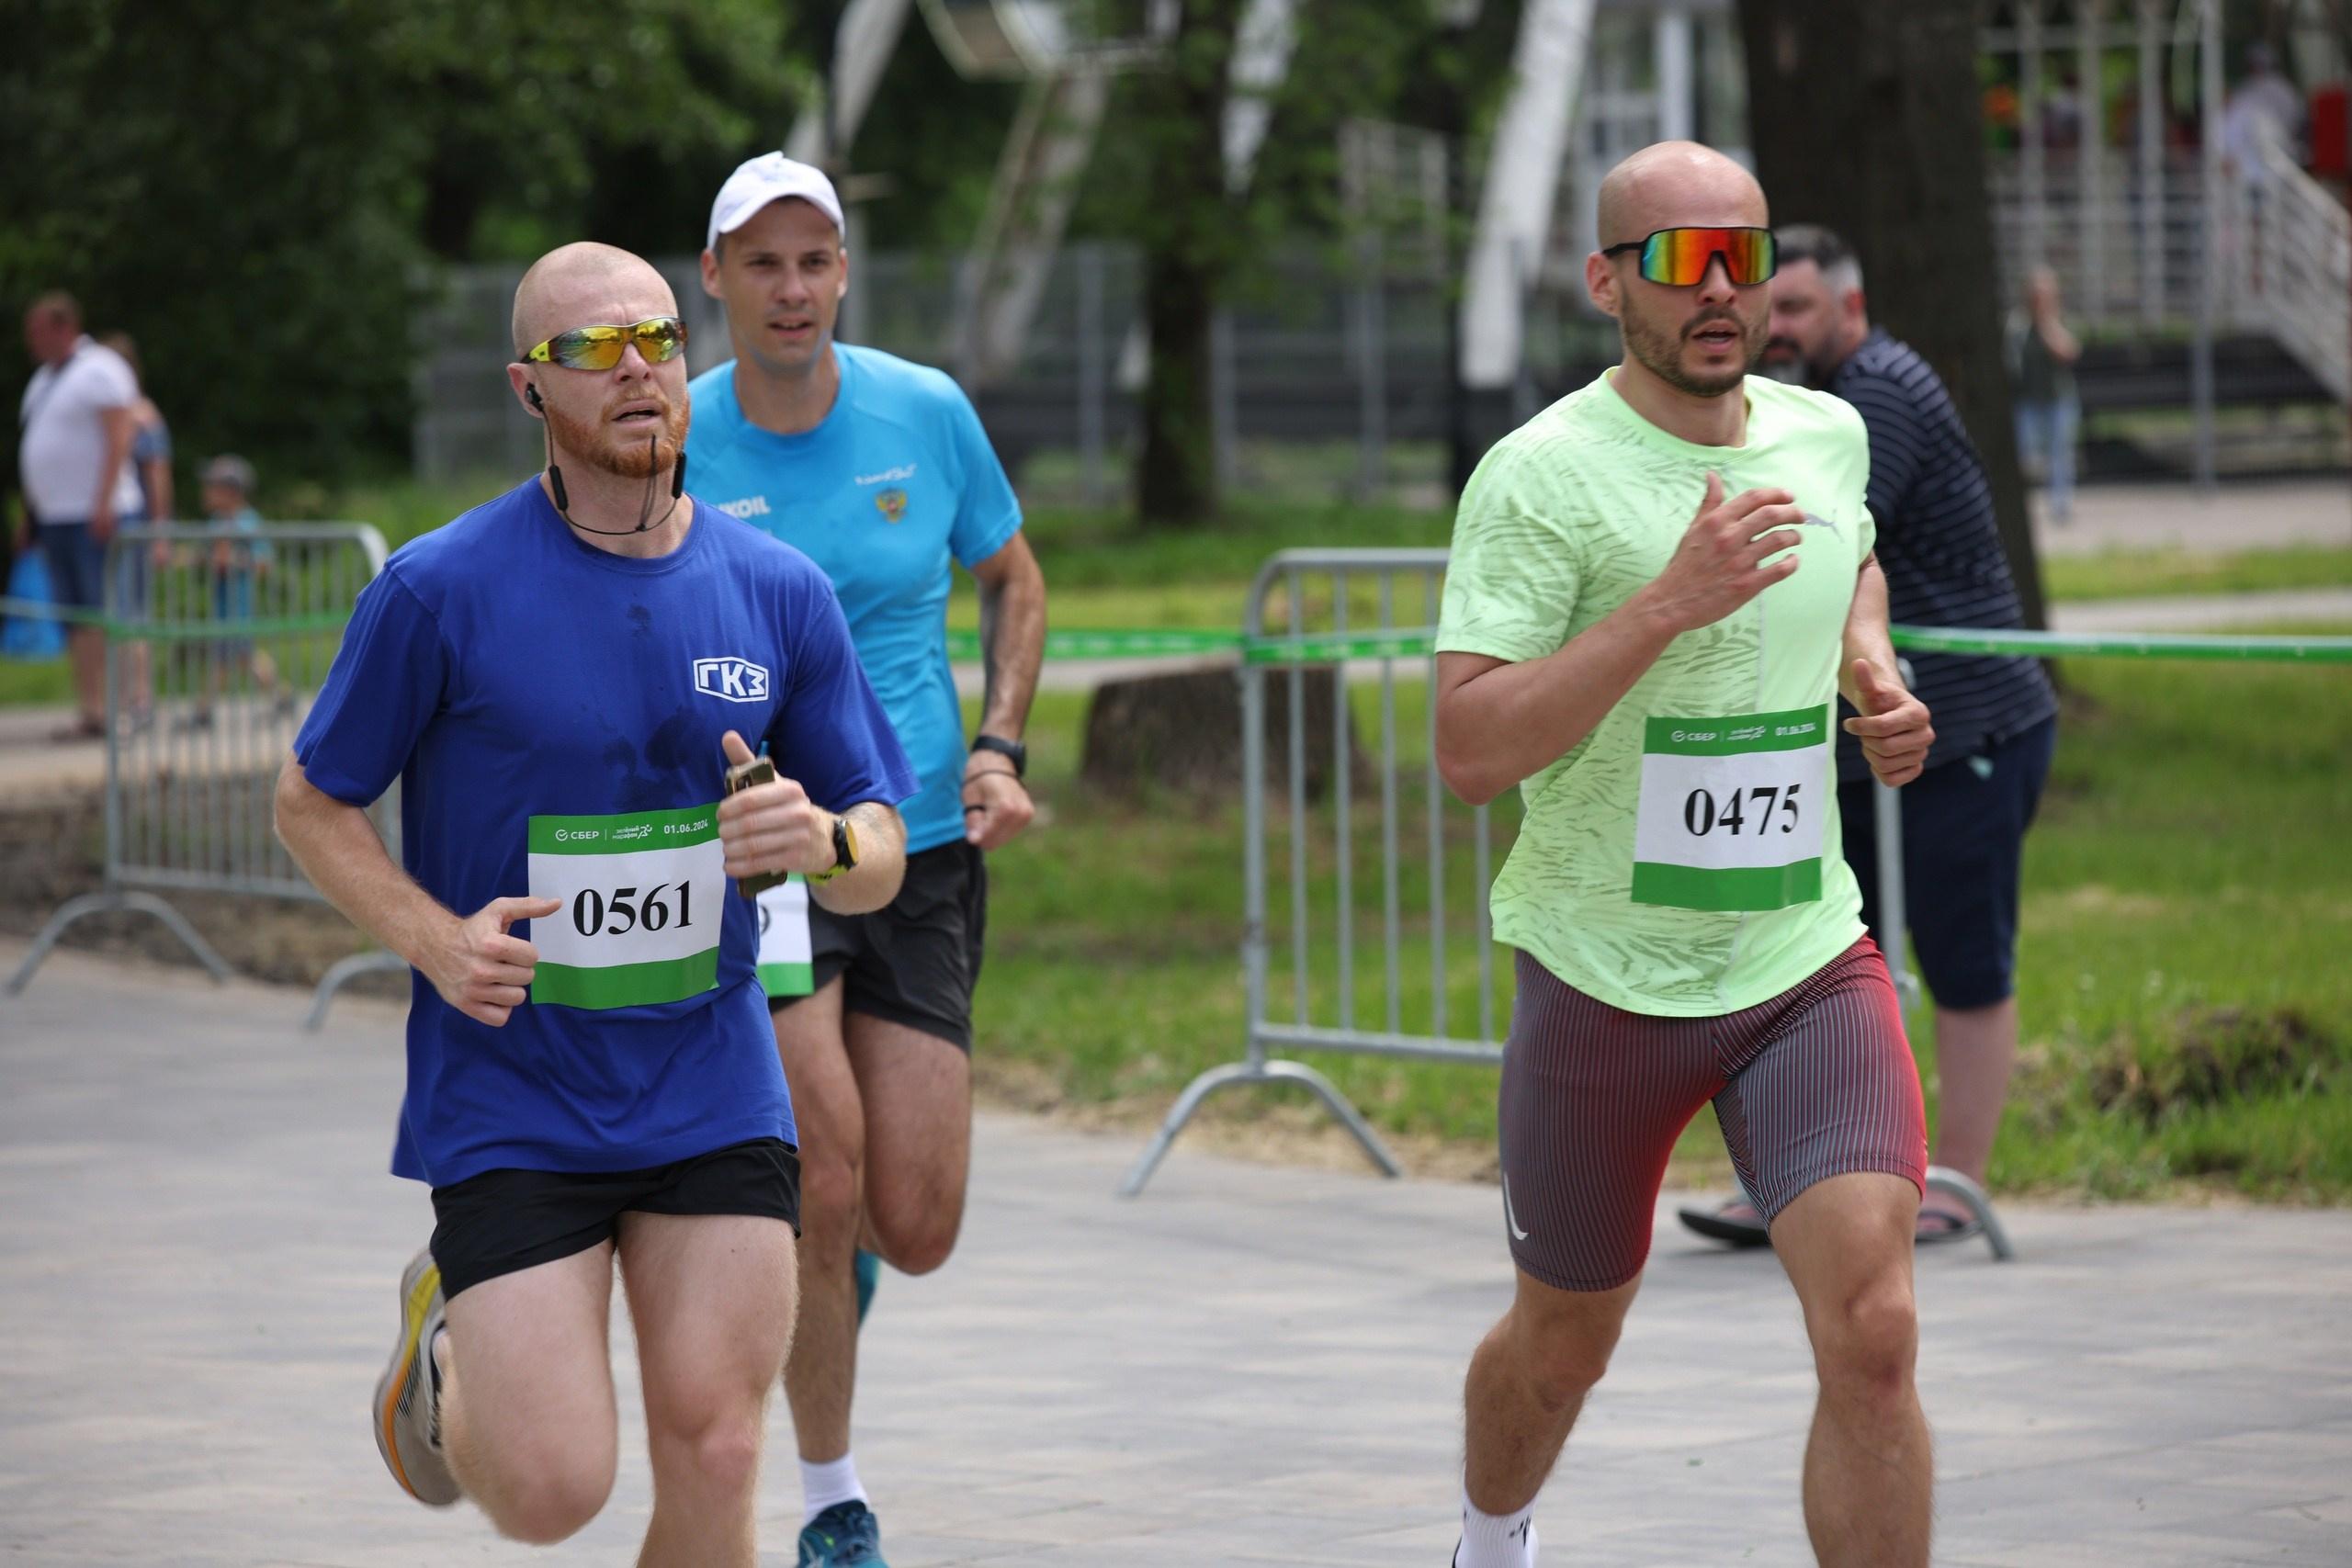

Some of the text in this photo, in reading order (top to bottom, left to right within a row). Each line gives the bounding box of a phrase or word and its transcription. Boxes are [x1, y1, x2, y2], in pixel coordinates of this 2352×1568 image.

[699, 662, 765, 696] ГКЗ
[663, 819, 708, 834] 01.06.2024
[1685, 784, 1801, 836] 0475
[571, 831, 599, 840] СБЕР
[573, 880, 693, 936] 0561
